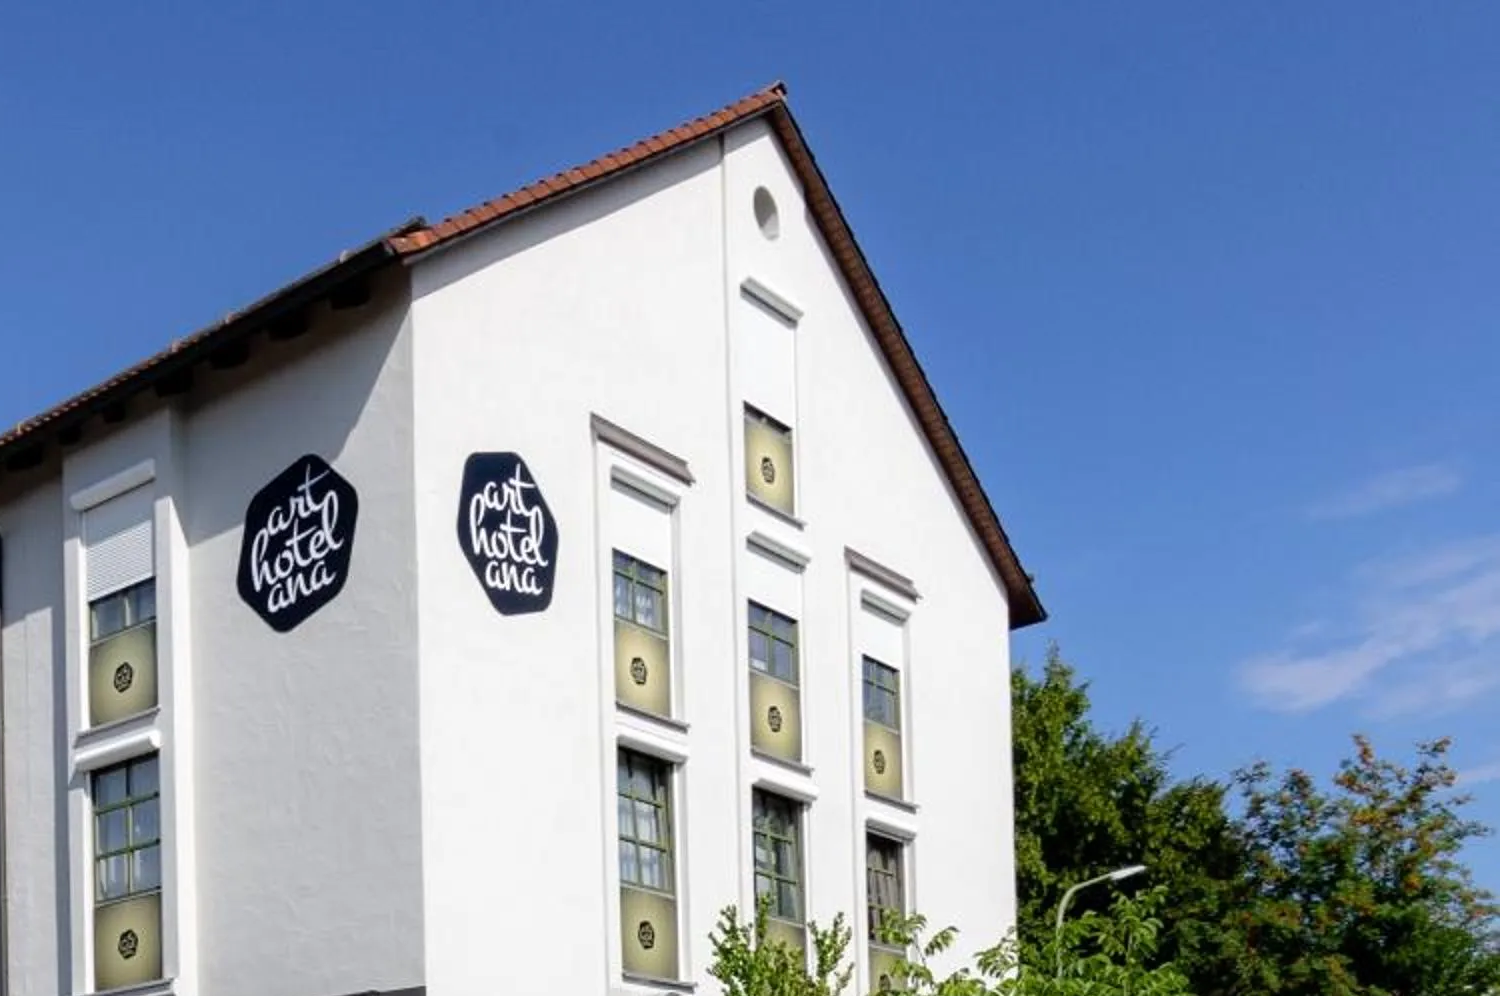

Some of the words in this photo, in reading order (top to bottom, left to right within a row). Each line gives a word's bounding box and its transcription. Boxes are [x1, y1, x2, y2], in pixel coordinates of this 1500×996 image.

[268, 463, 330, 536] art
[485, 464, 536, 516] art
[251, 490, 345, 592] hotel
[469, 493, 549, 566] hotel
[267, 560, 336, 613] ana
[485, 559, 543, 596] ana
